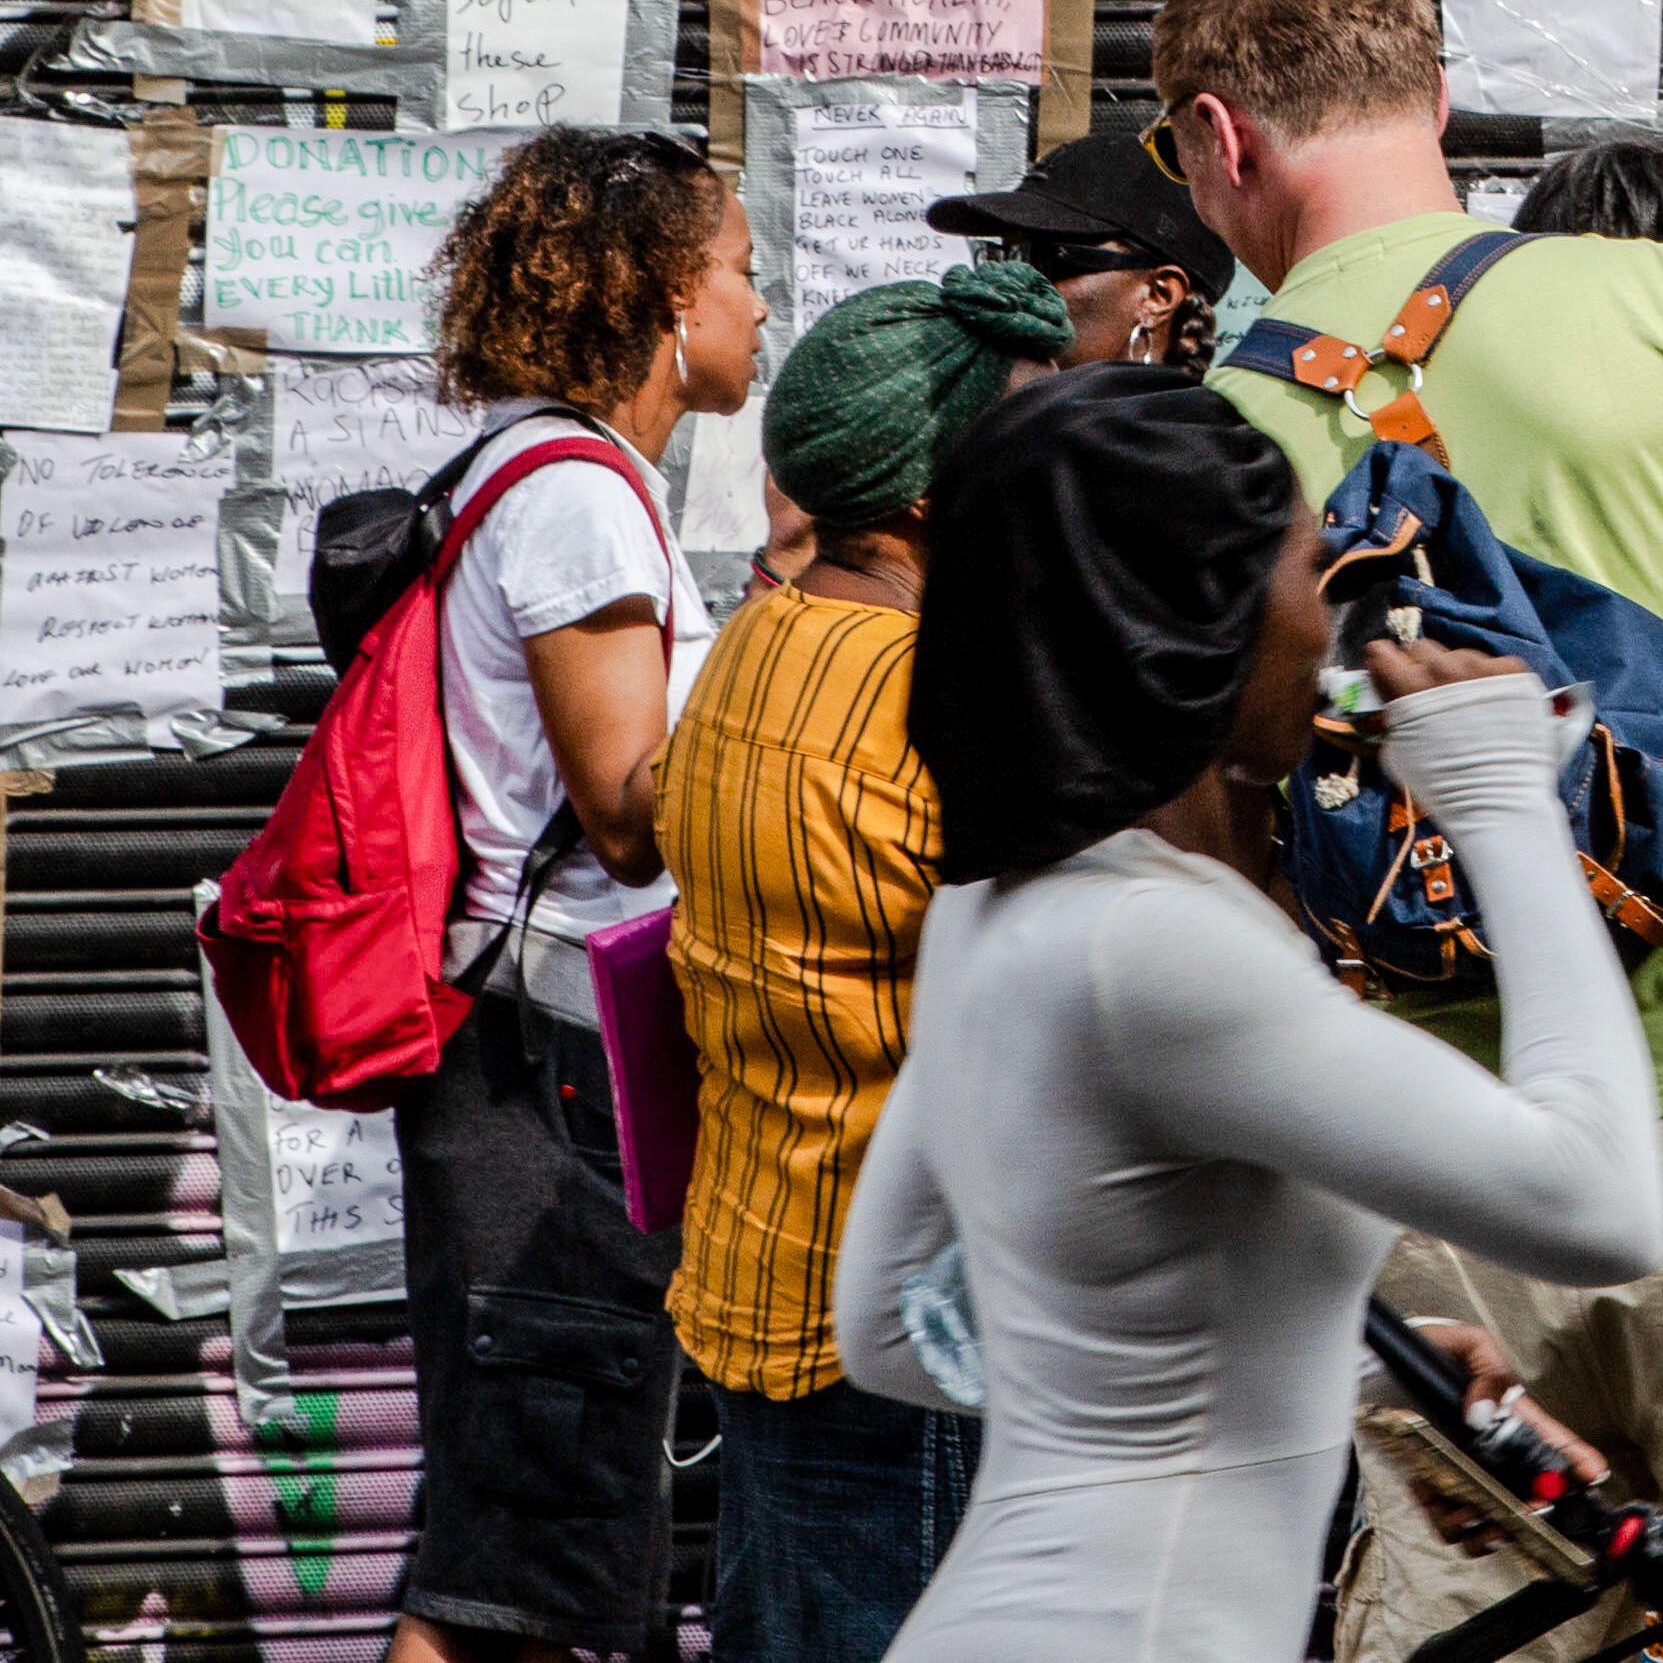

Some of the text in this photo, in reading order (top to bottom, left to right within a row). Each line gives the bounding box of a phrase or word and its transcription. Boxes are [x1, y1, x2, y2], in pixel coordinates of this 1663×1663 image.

[859, 17, 1002, 48] COMMUNITY
[799, 146, 925, 164] TOUCH ONE
[798, 165, 921, 184] TOUCH ALL
[212, 176, 449, 241] Please give
[800, 191, 852, 208] LEAVE
[315, 234, 394, 264] can
[880, 235, 943, 250] HANDS
[796, 257, 940, 282] OFF WE NECK
[273, 1115, 363, 1154] FOR A
[276, 1161, 362, 1200] OVER
